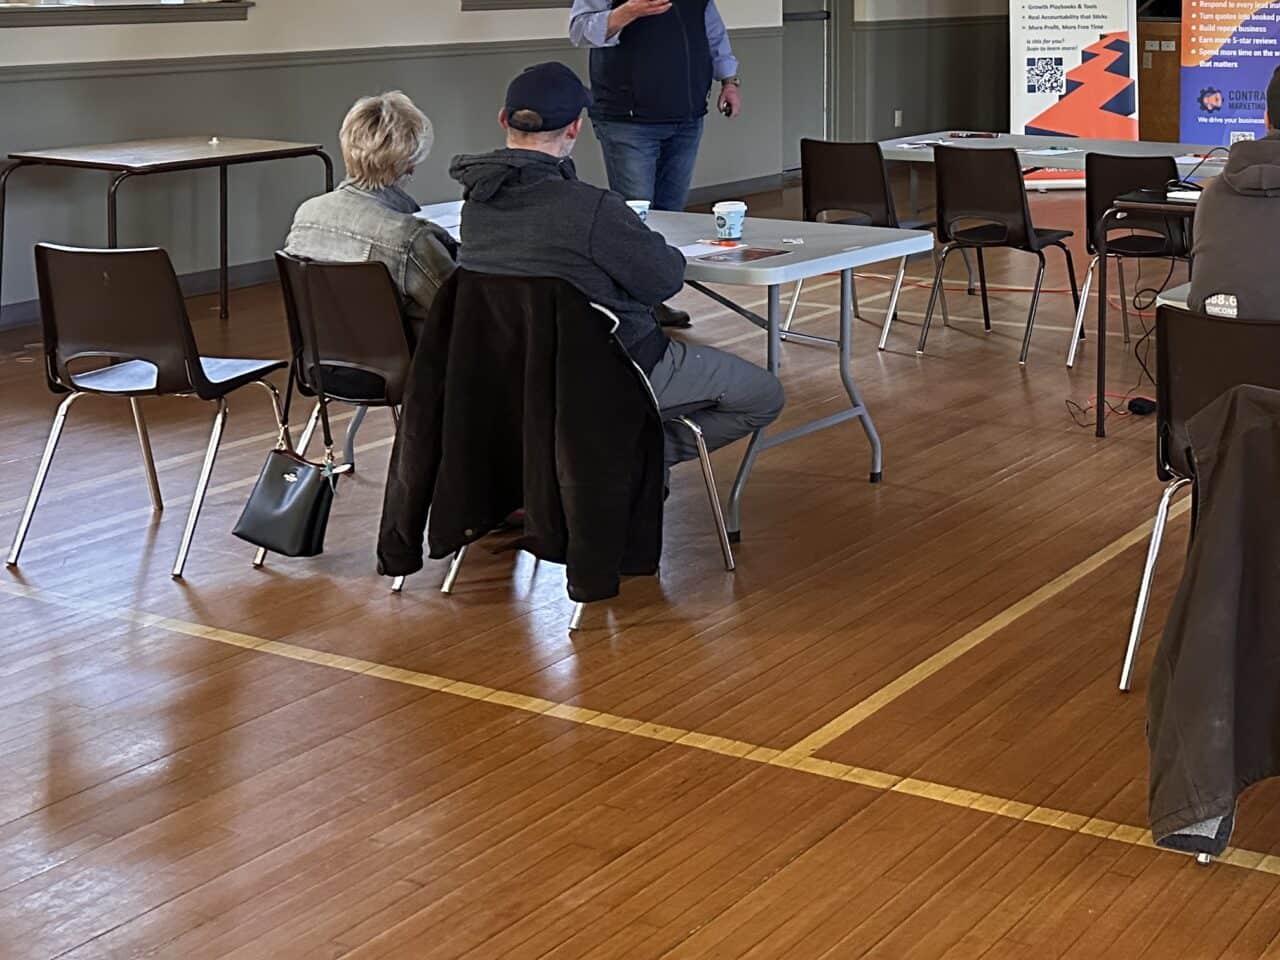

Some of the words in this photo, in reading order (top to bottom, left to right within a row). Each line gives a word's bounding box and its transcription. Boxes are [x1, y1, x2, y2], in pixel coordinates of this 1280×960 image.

[1200, 1, 1228, 9] Respond
[1236, 2, 1253, 10] every
[1215, 13, 1237, 21] quotes
[1252, 13, 1275, 21] booked
[1216, 25, 1237, 33] repeat
[1199, 48, 1219, 56] Spend
[1229, 90, 1265, 101] CONTRA
